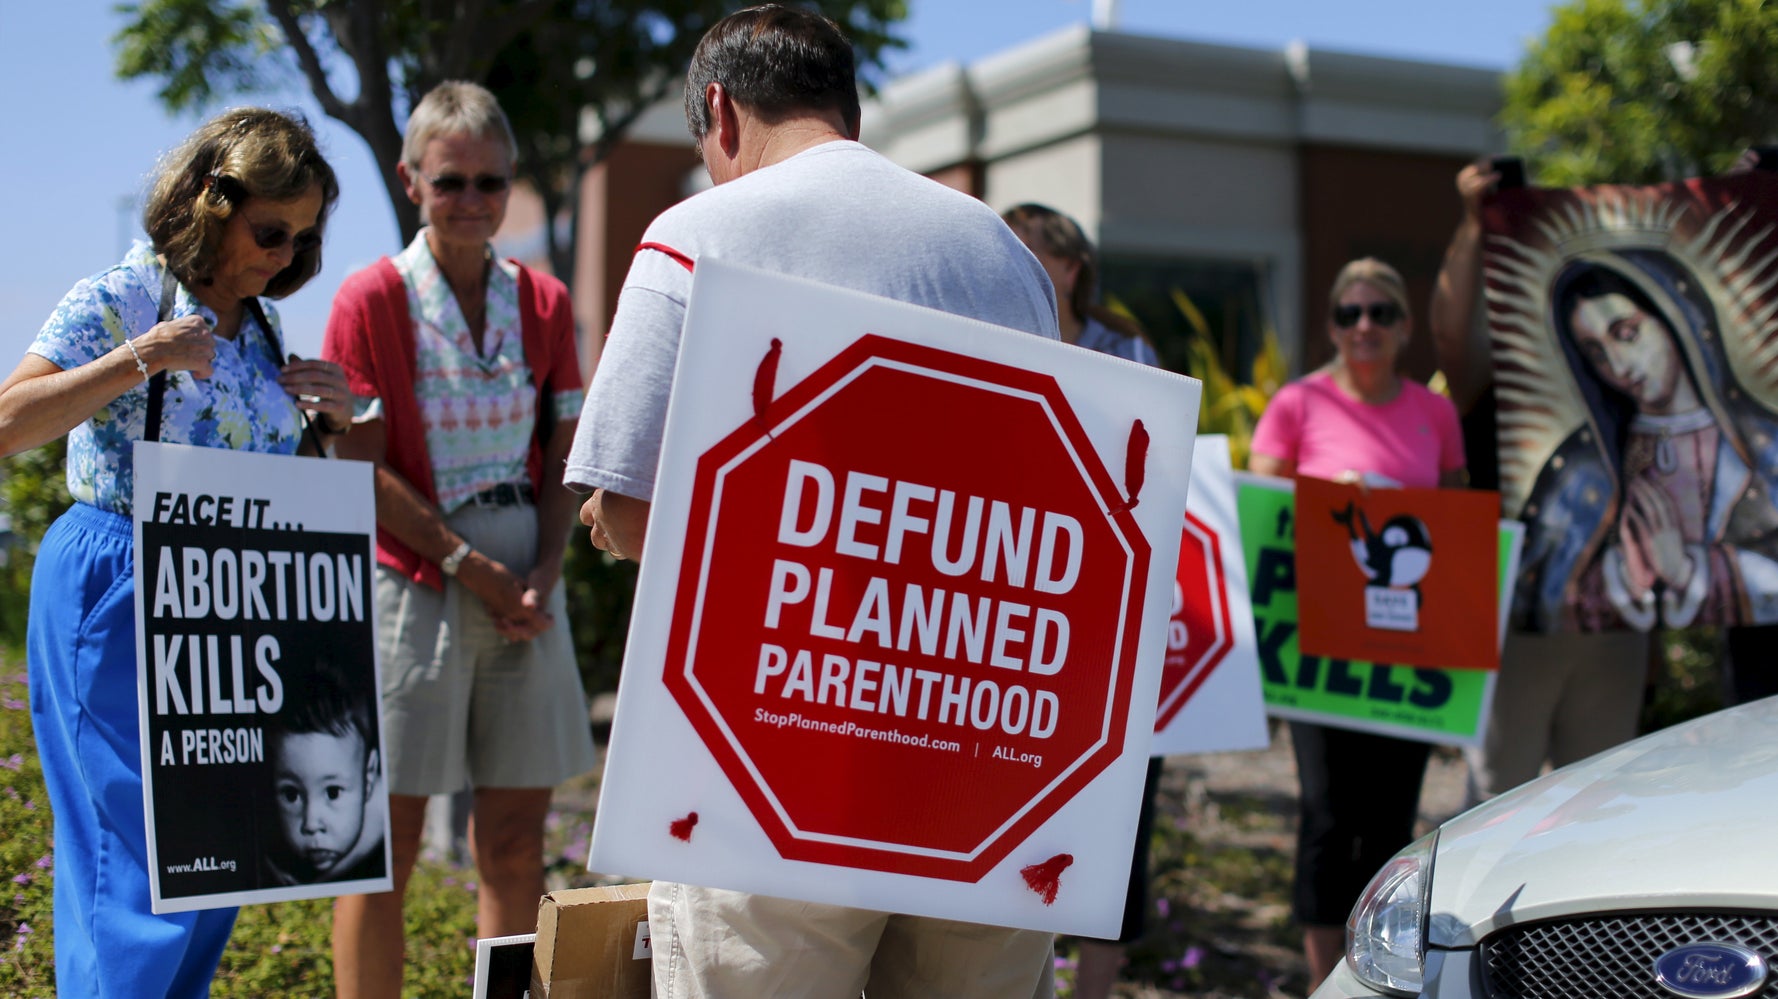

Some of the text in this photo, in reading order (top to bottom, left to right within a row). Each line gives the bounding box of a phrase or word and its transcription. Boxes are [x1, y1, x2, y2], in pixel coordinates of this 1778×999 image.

[152, 491, 234, 528] FACE
[777, 458, 1084, 595] DEFUND
[153, 545, 364, 622] ABORTION
[763, 558, 1071, 676] PLANNED
[154, 634, 284, 715] KILLS
[754, 643, 1060, 739] PARENTHOOD
[160, 727, 264, 766] A PERSON
[754, 708, 1043, 768] StopPlannedParenthood.com ALL.org
[167, 856, 237, 874] www.ALL.org
[1676, 953, 1735, 985] Ford
